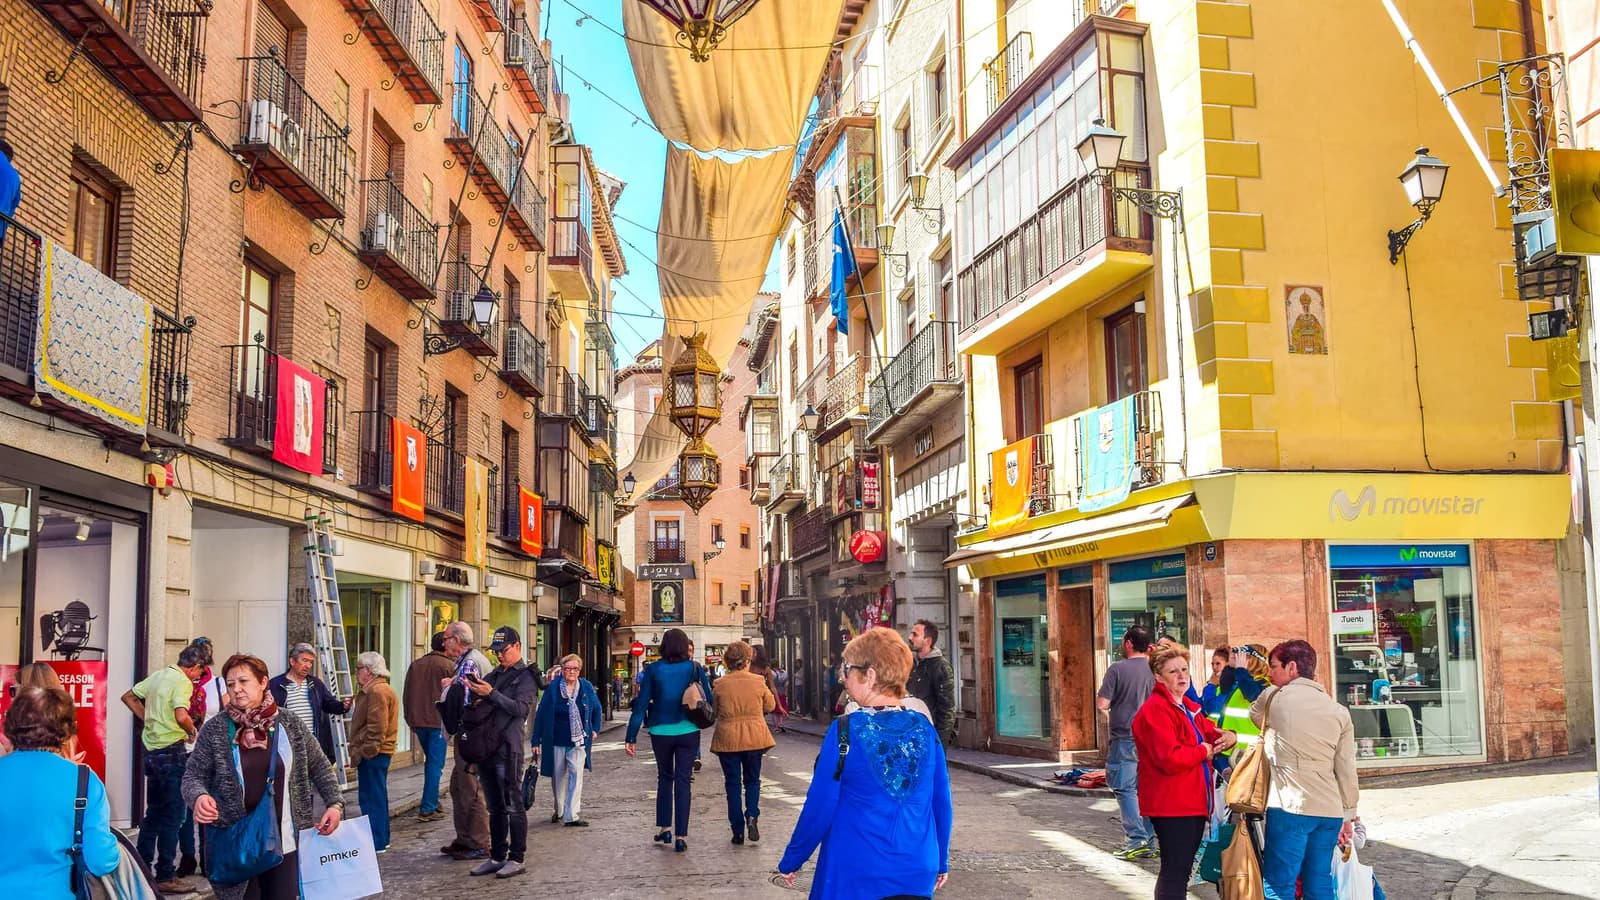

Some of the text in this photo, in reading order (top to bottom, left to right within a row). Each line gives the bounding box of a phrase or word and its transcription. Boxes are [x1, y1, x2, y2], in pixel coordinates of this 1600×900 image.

[1383, 496, 1484, 515] movistar
[1419, 549, 1457, 560] movistar
[434, 563, 470, 587] ZARA
[59, 674, 94, 684] SEASON
[319, 848, 359, 866] pimkie
